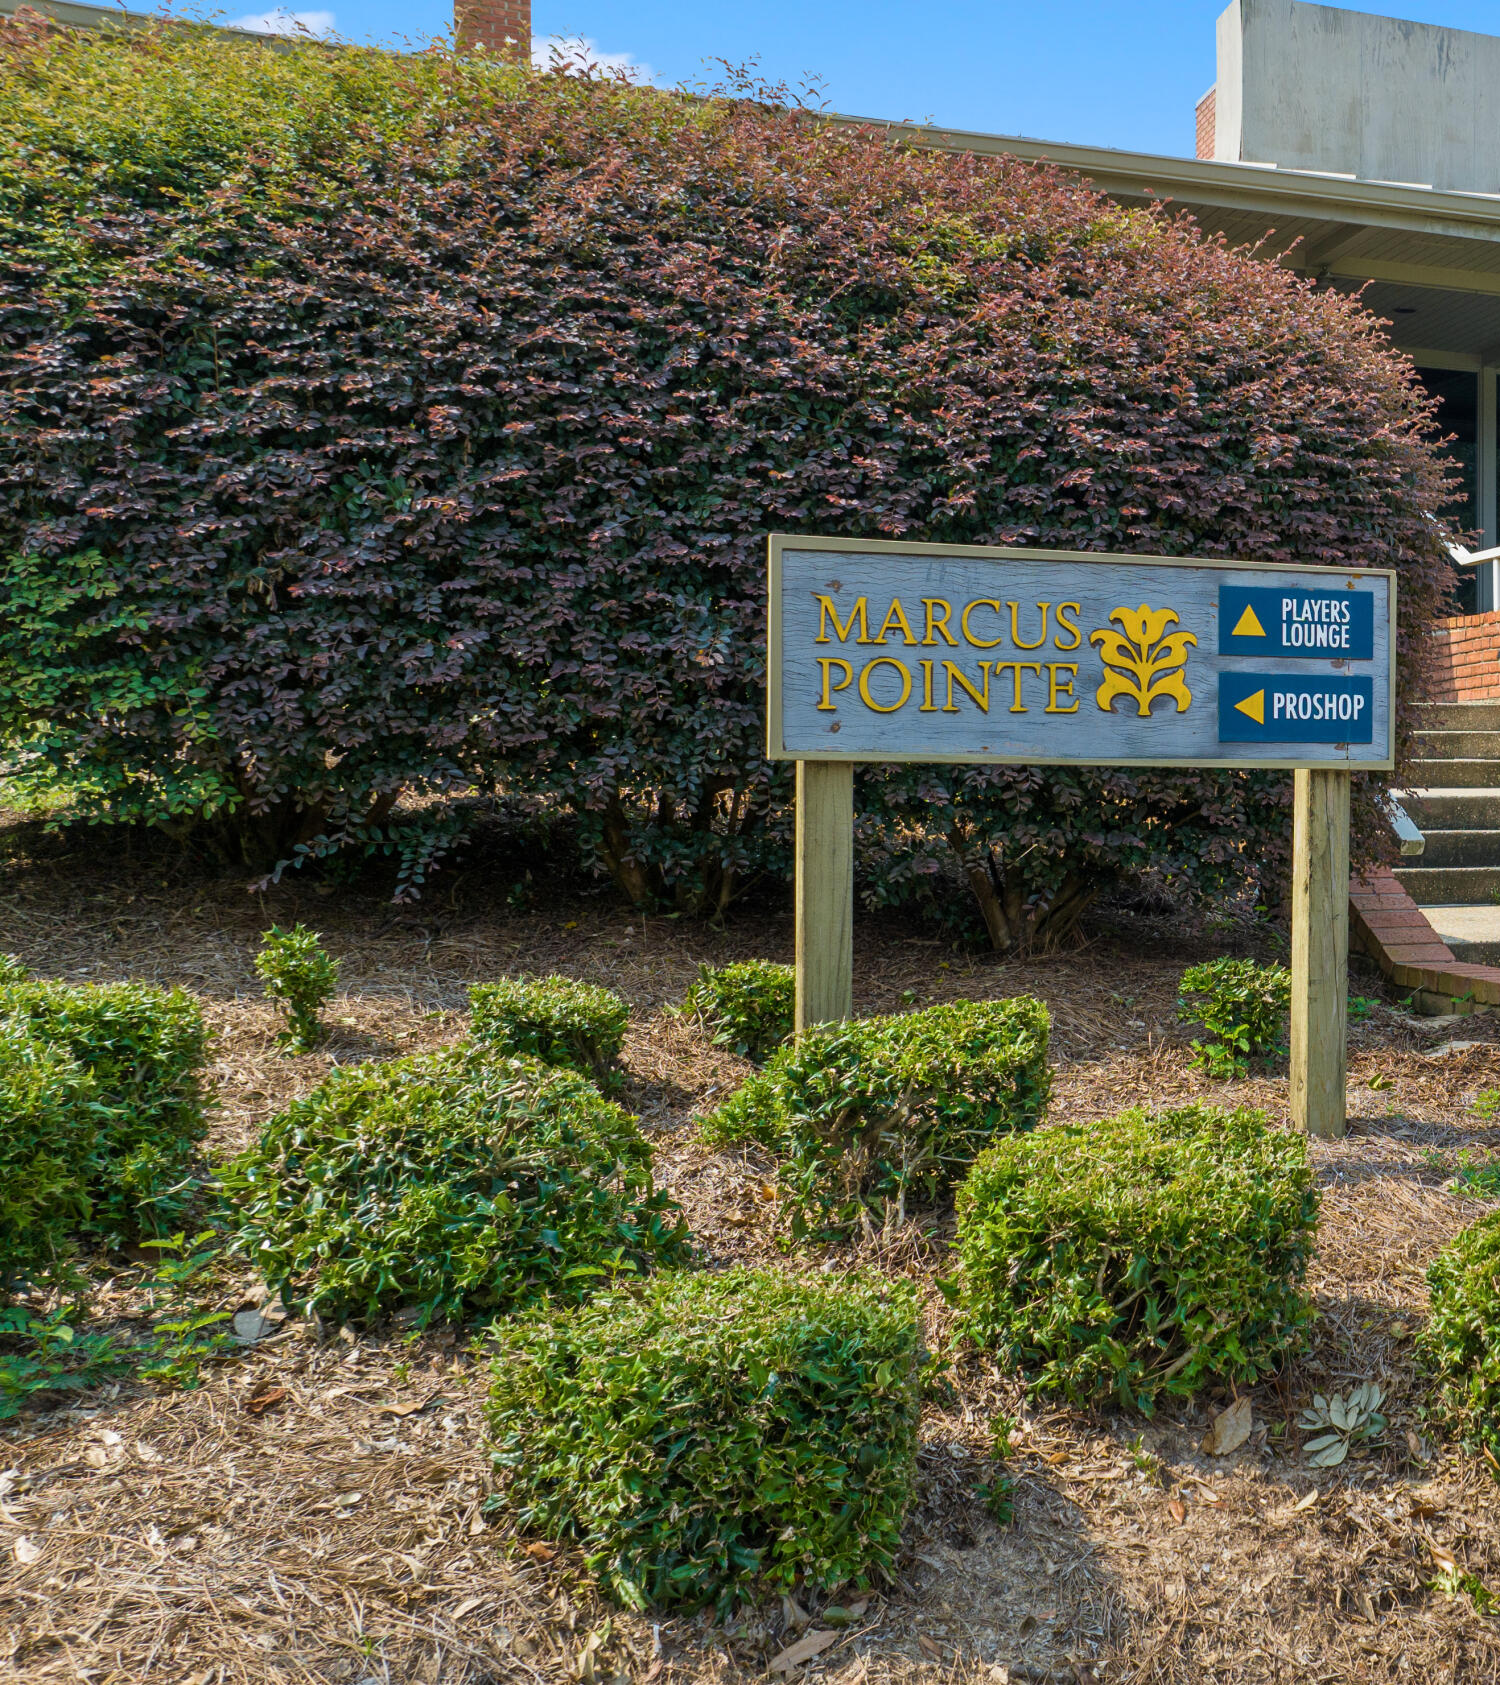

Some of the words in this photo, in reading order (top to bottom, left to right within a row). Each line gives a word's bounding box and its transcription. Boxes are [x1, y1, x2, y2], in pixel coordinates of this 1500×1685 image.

[814, 595, 1082, 650] MARCUS
[1281, 598, 1351, 623] PLAYERS
[1281, 622, 1351, 648] LOUNGE
[817, 657, 1080, 713] POINTE
[1273, 692, 1365, 721] PROSHOP
